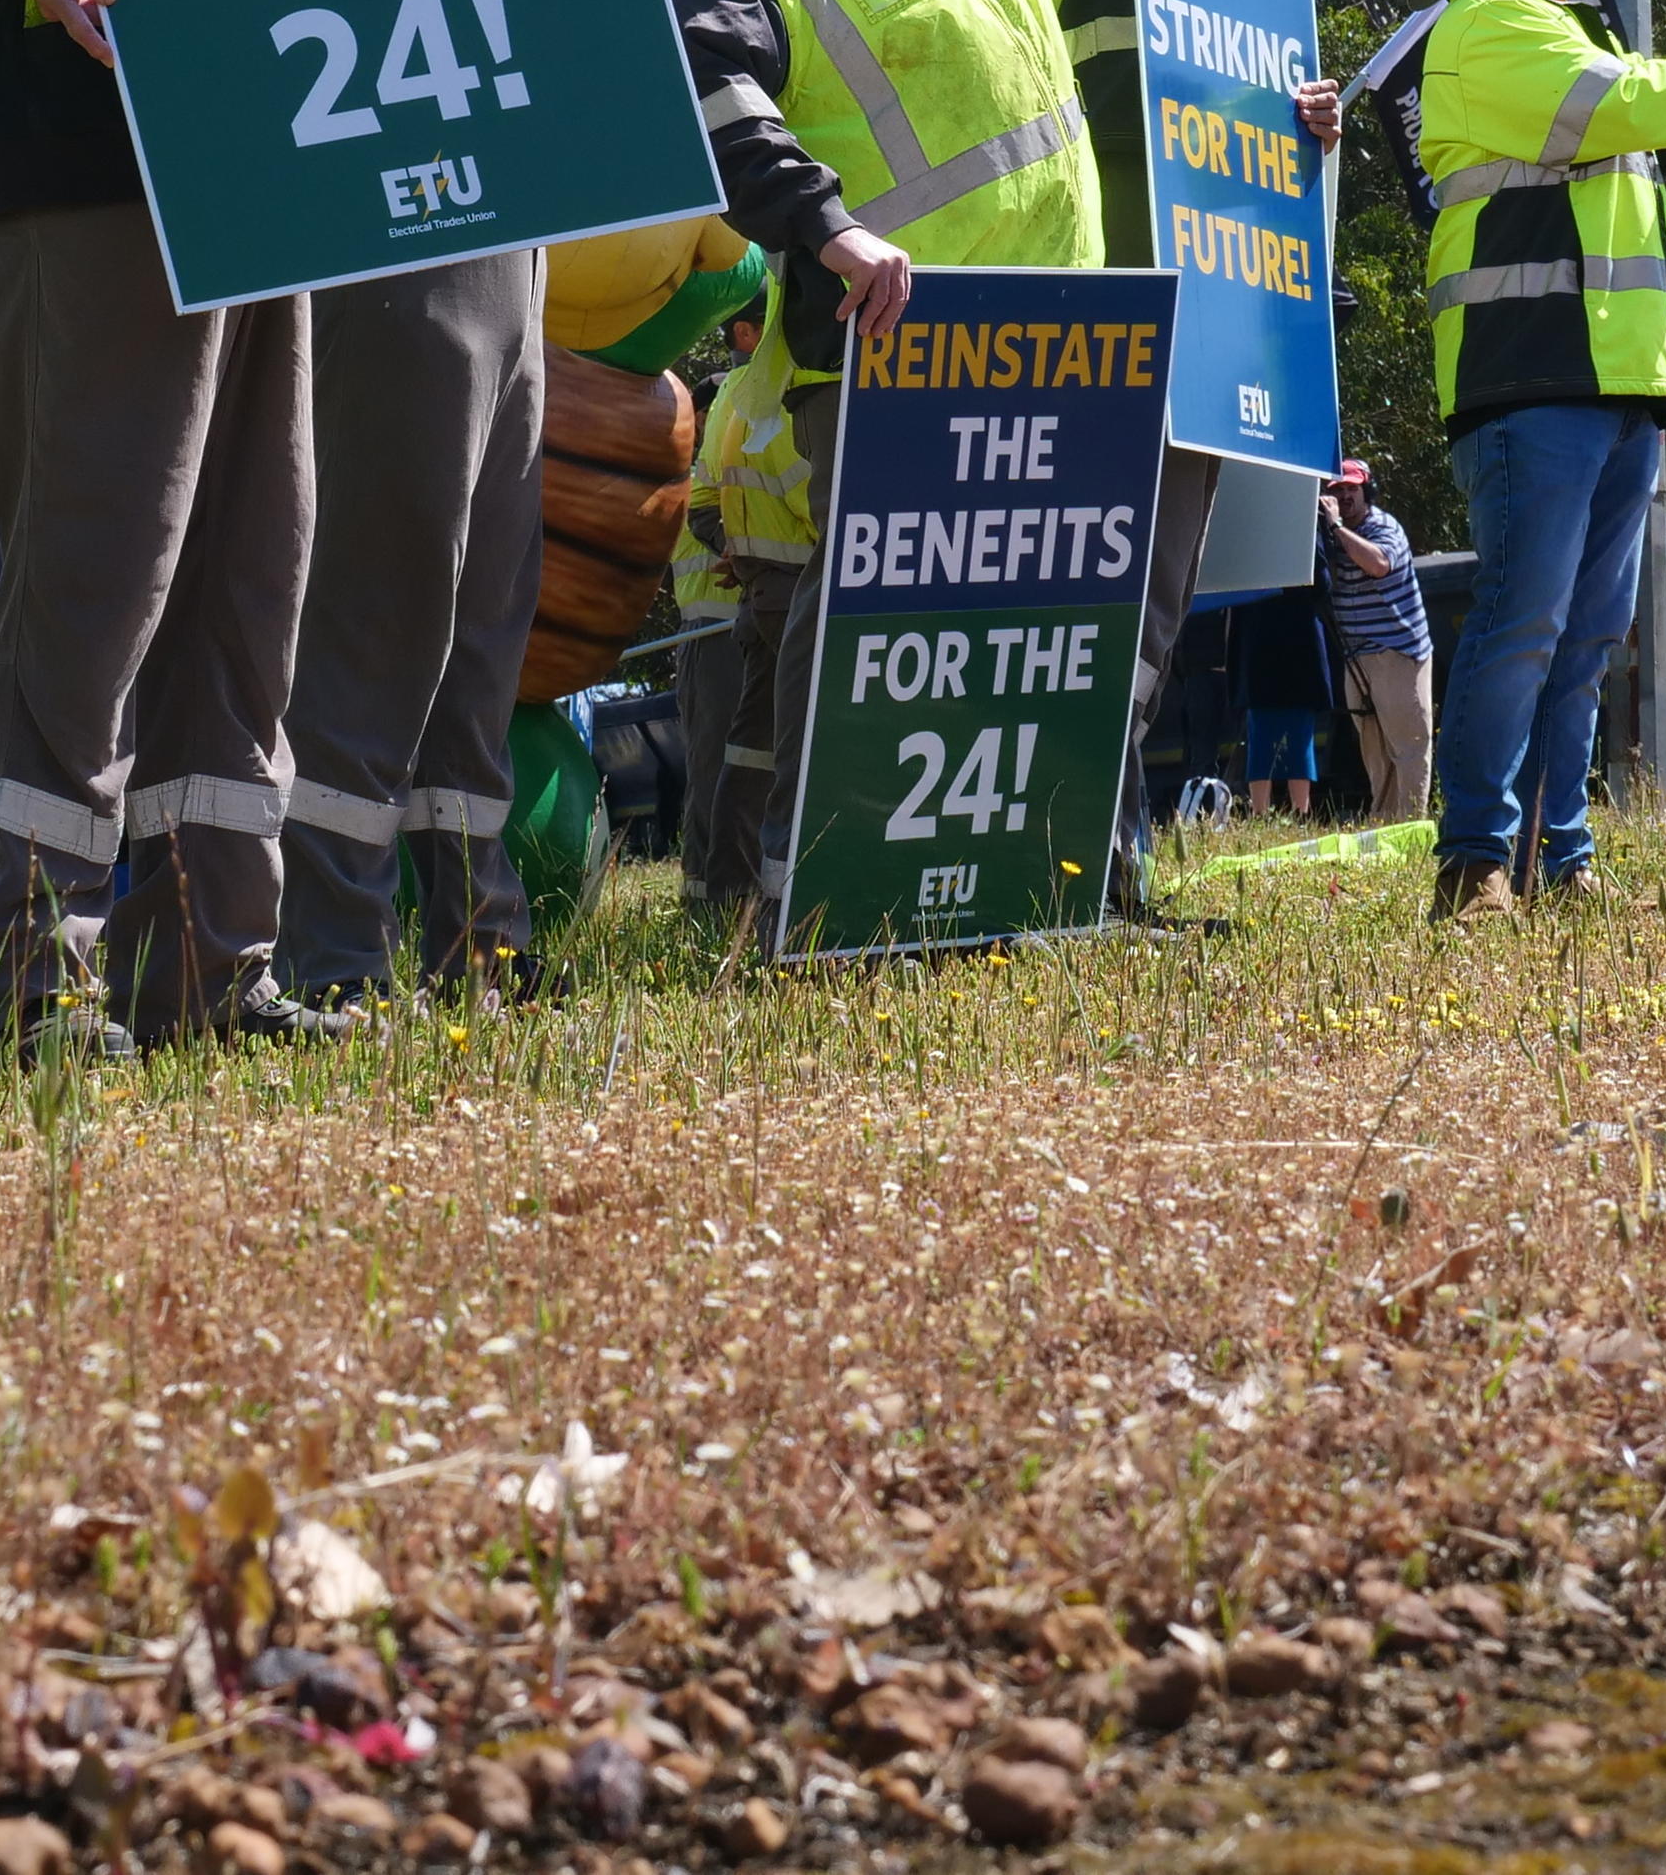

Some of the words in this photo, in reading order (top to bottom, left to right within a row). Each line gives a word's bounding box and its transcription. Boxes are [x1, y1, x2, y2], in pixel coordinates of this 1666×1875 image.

[1161, 97, 1231, 178] FOR
[1234, 119, 1302, 199] THE
[380, 154, 483, 219] ETU
[388, 221, 433, 239] Electrical
[433, 215, 466, 230] Trades
[466, 210, 497, 224] Union
[1171, 204, 1312, 302] FUTURE!
[857, 323, 1158, 390] REINSTATE
[1238, 384, 1271, 426] ETU
[949, 416, 1059, 482] THE
[839, 505, 1135, 589] BENEFITS
[851, 631, 970, 704] FOR
[985, 625, 1100, 697] THE
[884, 722, 1040, 842] 24!
[917, 864, 979, 907] ETU
